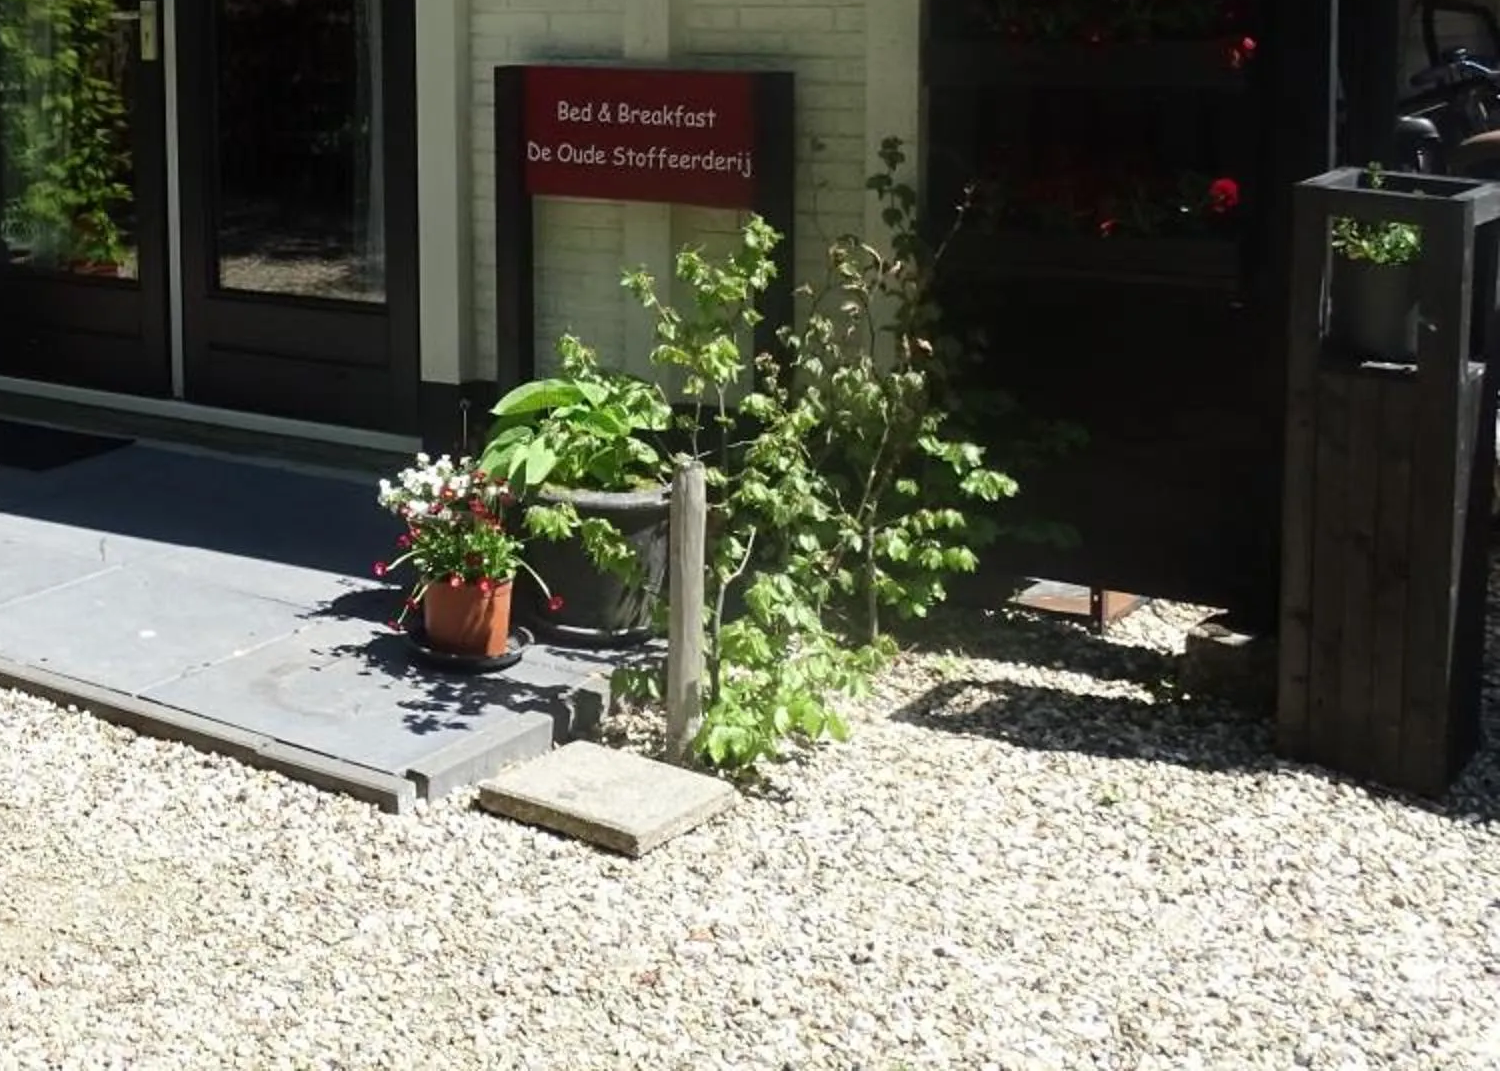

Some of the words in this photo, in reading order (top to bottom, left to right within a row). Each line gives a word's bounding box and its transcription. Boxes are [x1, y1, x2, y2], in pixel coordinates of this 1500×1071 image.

[557, 100, 592, 122] Bed
[597, 103, 611, 123] &
[617, 103, 717, 128] Breakfast
[527, 141, 551, 161] De
[557, 142, 605, 165] Oude
[612, 146, 752, 178] Stoffeerderij
